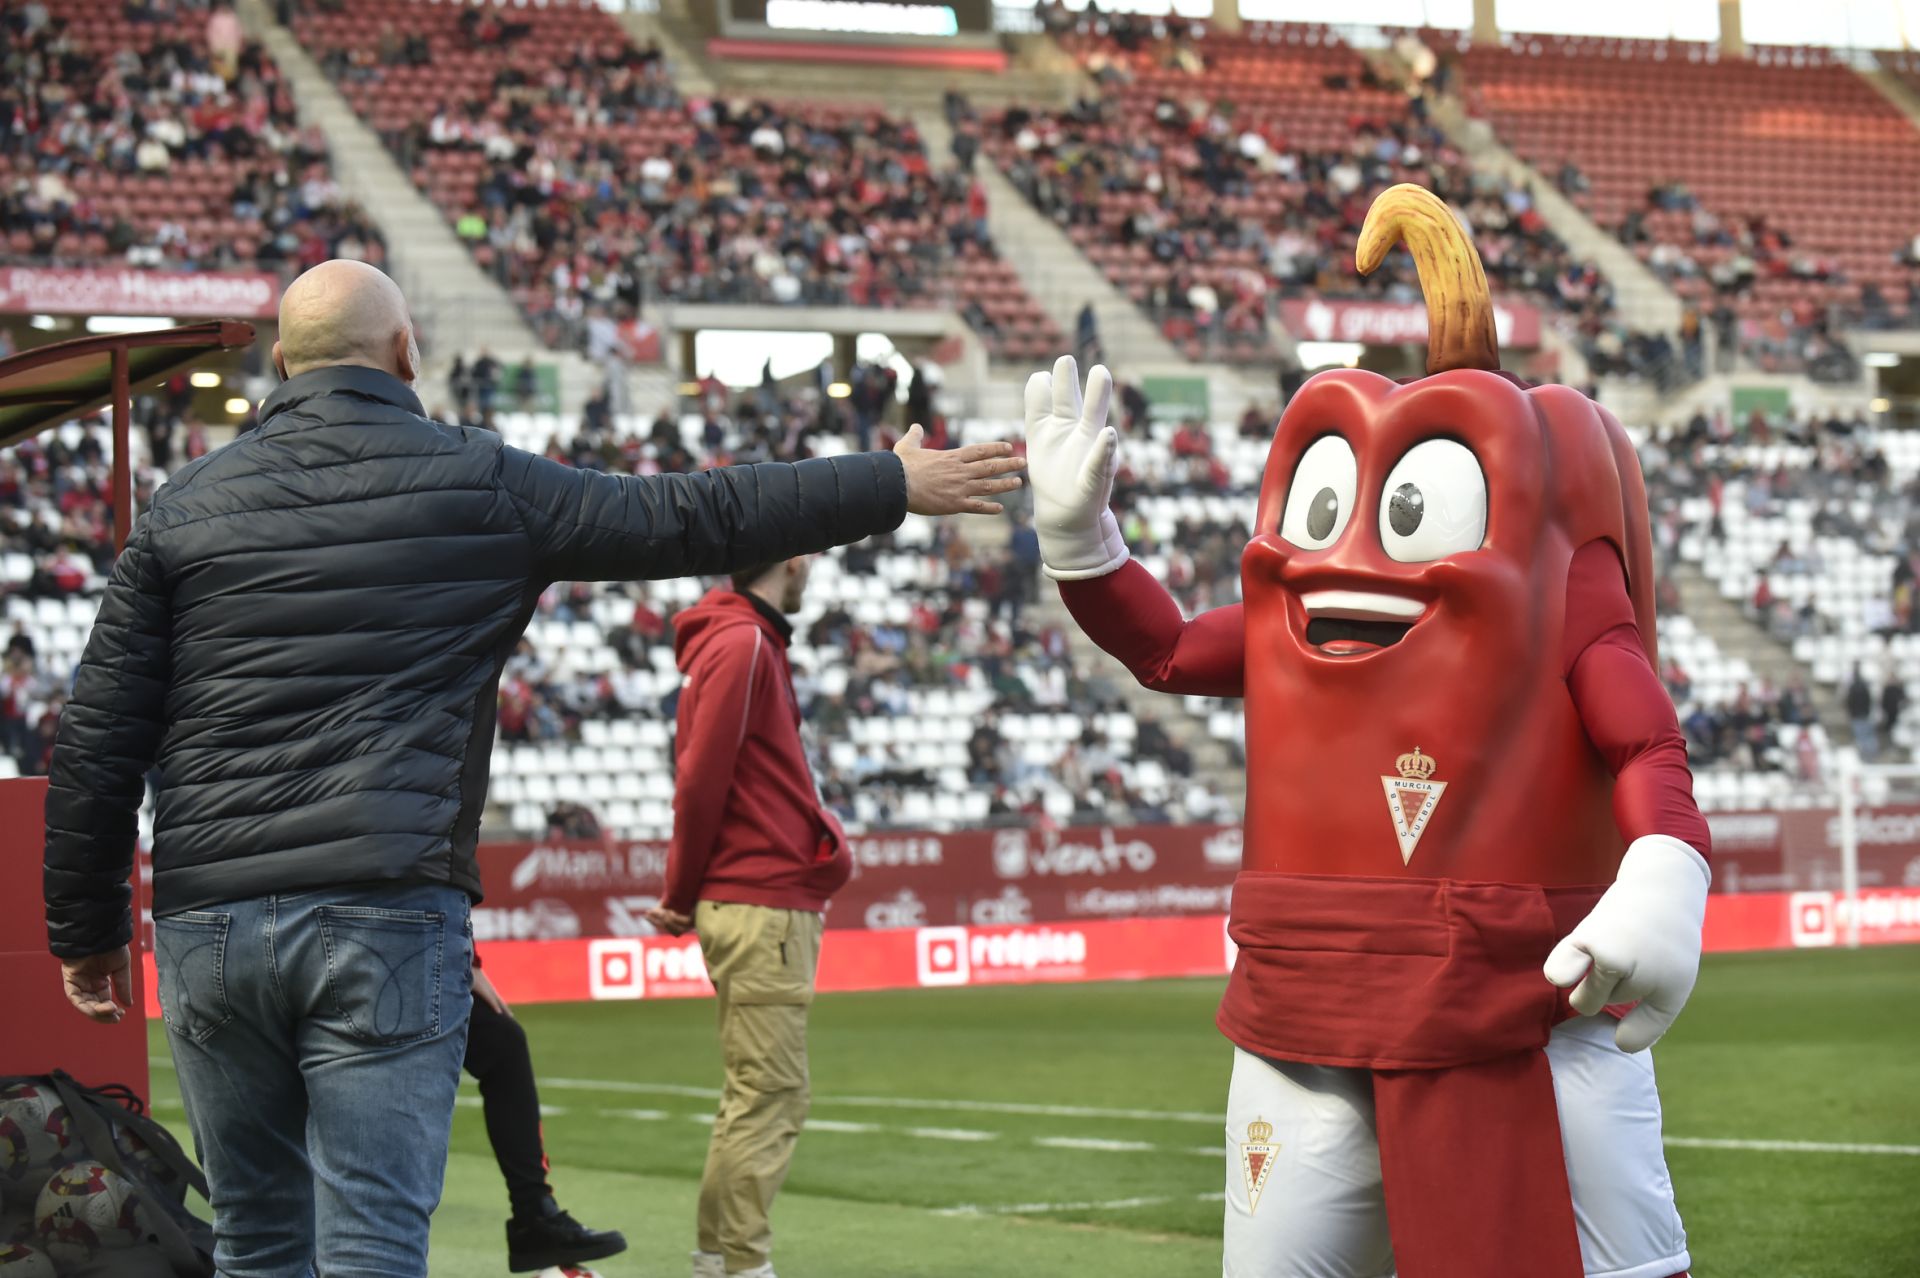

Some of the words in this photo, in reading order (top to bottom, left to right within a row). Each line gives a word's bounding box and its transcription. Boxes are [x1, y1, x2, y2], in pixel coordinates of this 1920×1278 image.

[1394, 781, 1432, 790] MURCIA
[1390, 793, 1407, 837] CLUB
[1409, 795, 1436, 838] FUTBOL
[970, 929, 1086, 970] redpiso
